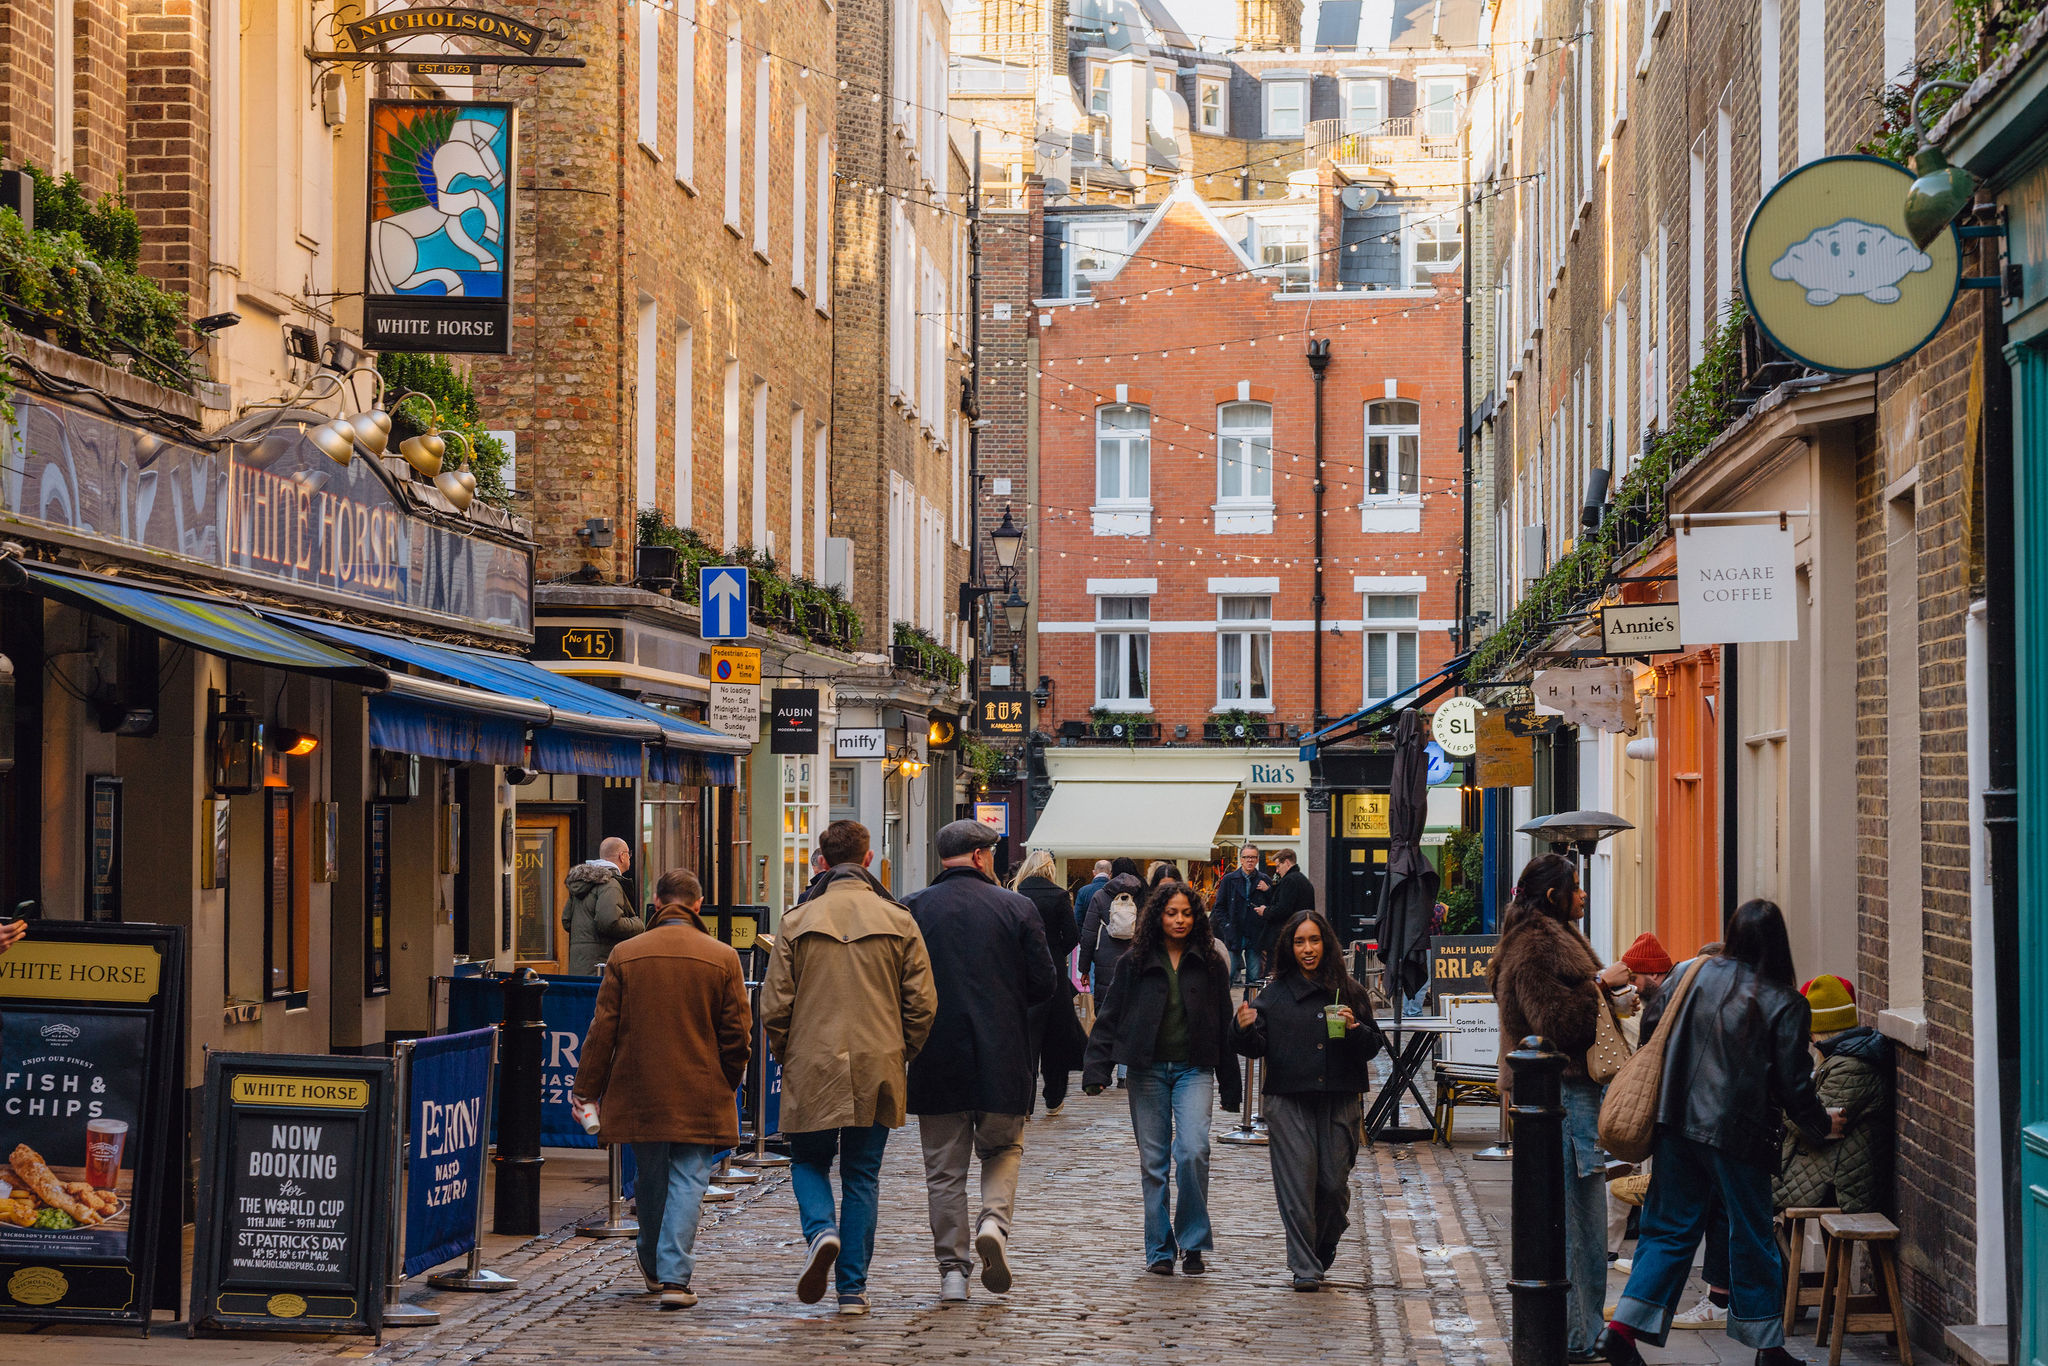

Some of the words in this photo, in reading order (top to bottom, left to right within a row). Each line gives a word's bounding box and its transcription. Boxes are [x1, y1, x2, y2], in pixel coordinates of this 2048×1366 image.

[359, 12, 533, 47] NICHOLSON'S
[377, 319, 430, 335] WHITE
[436, 320, 494, 336] HORSE
[232, 461, 312, 571] WHITE
[319, 491, 399, 592] HORSE
[1700, 566, 1775, 582] NAGARE
[1703, 587, 1773, 602] COFFEE
[1610, 616, 1674, 635] Annie's
[583, 634, 606, 654] 15
[730, 687, 751, 695] loading
[715, 705, 739, 713] Midnight
[777, 708, 813, 717] AUBIN
[985, 701, 1022, 720] 金田家
[732, 714, 757, 722] Midnight
[1437, 707, 1449, 729] SKIN
[1450, 719, 1474, 734] SL
[724, 723, 745, 731] Sunday
[839, 735, 877, 750] miffy
[1251, 764, 1295, 783] Ria's
[1369, 803, 1378, 813] 31
[1440, 946, 1467, 954] RALPH
[69, 964, 146, 984] HORSE
[22, 1056, 46, 1066] ENJOY
[67, 1057, 94, 1069] FINEST
[5, 1072, 79, 1093] FISH
[90, 1076, 107, 1094] &
[243, 1083, 296, 1098] WHITE
[302, 1085, 358, 1100] HORSE
[5, 1097, 104, 1118] CHIPS
[272, 1125, 322, 1151] NOW
[249, 1151, 337, 1179] BOOKING
[280, 1179, 307, 1197] for
[239, 1197, 261, 1214] THE
[319, 1200, 345, 1217] CUP
[247, 1217, 264, 1227] 11TH
[265, 1218, 286, 1227] JUNE
[296, 1219, 315, 1228] 19TH
[317, 1219, 337, 1229] JULY
[256, 1234, 320, 1250] PATRICK'S
[322, 1237, 347, 1251] DAY
[310, 1251, 329, 1261] MAR
